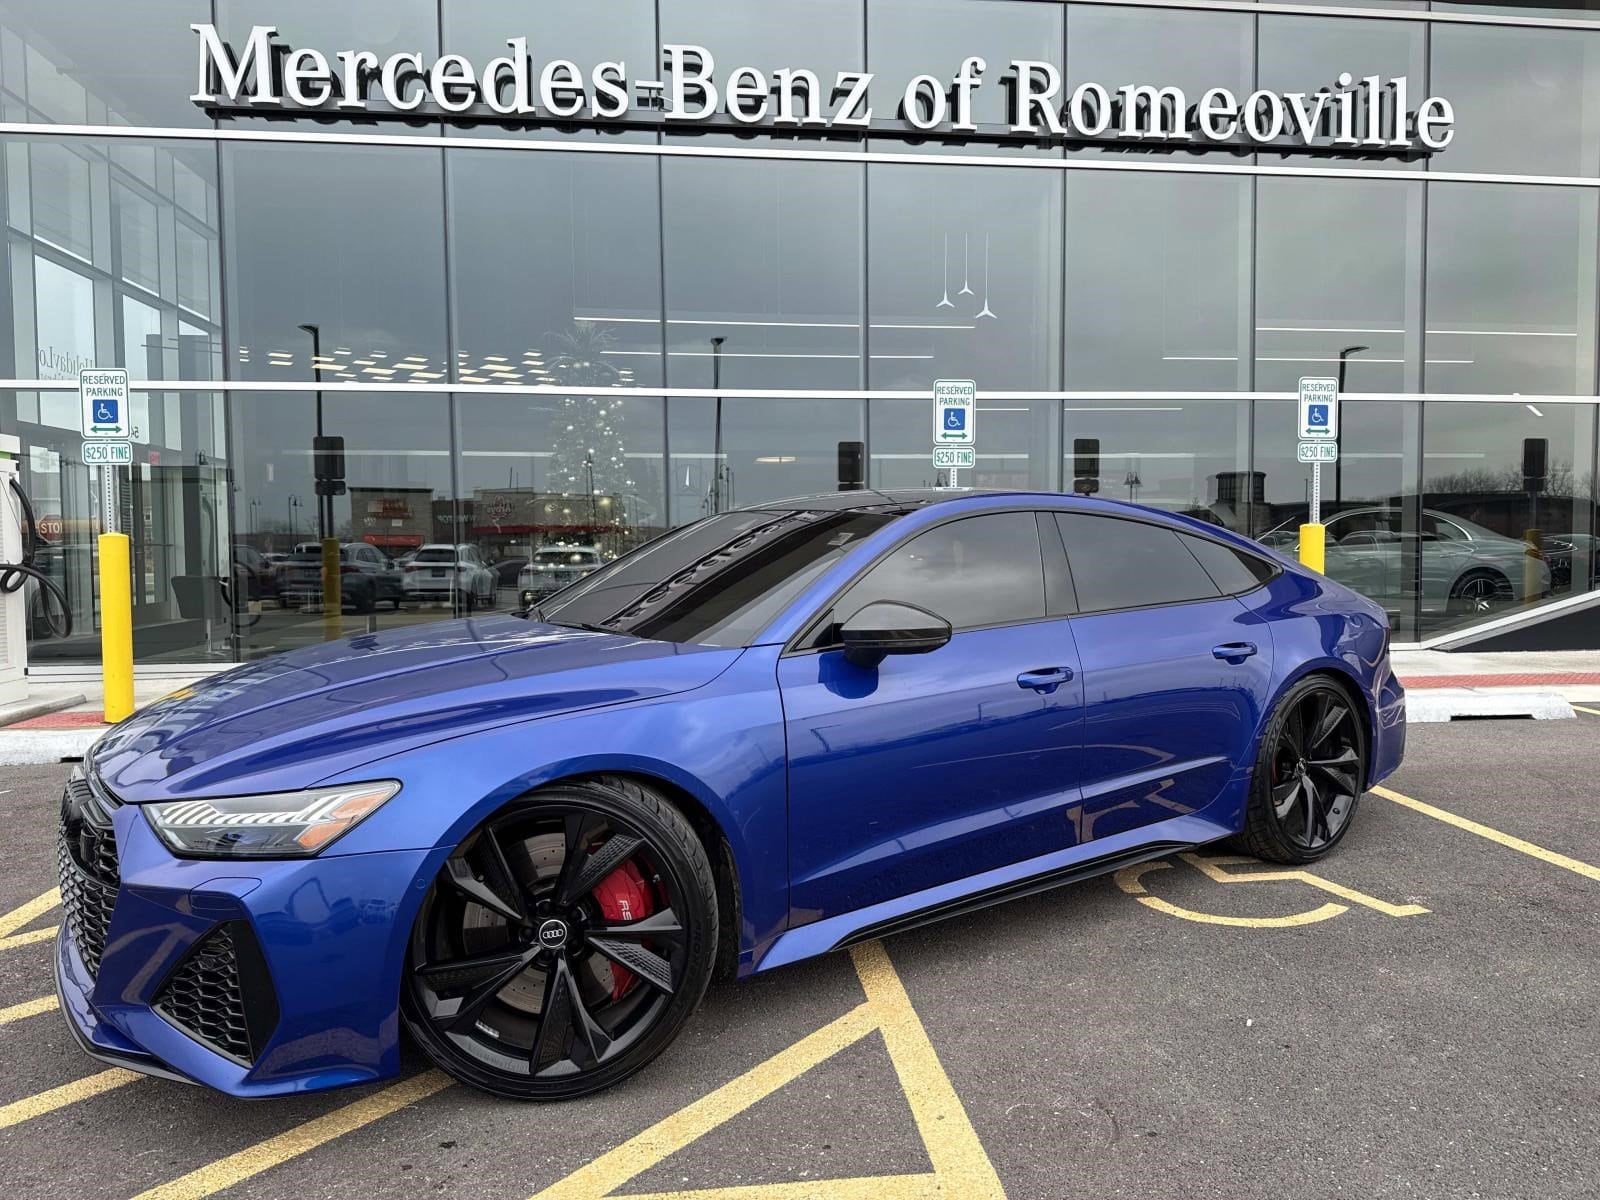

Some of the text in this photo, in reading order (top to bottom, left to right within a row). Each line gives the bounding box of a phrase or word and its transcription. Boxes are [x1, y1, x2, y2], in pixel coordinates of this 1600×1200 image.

[189, 22, 1455, 150] Mercedes-Benz of Romeoville
[82, 375, 125, 385] RESERVED
[86, 387, 123, 397] PARKING
[936, 386, 973, 395] RESERVED
[1302, 383, 1336, 392] RESERVED
[939, 397, 970, 406] PARKING
[1303, 394, 1333, 403] PARKING
[86, 446, 129, 460] $250 FINE
[936, 451, 973, 464] $250 FINE
[1300, 446, 1335, 458] $250 FINE
[40, 522, 63, 534] STO
[619, 900, 633, 920] RS
